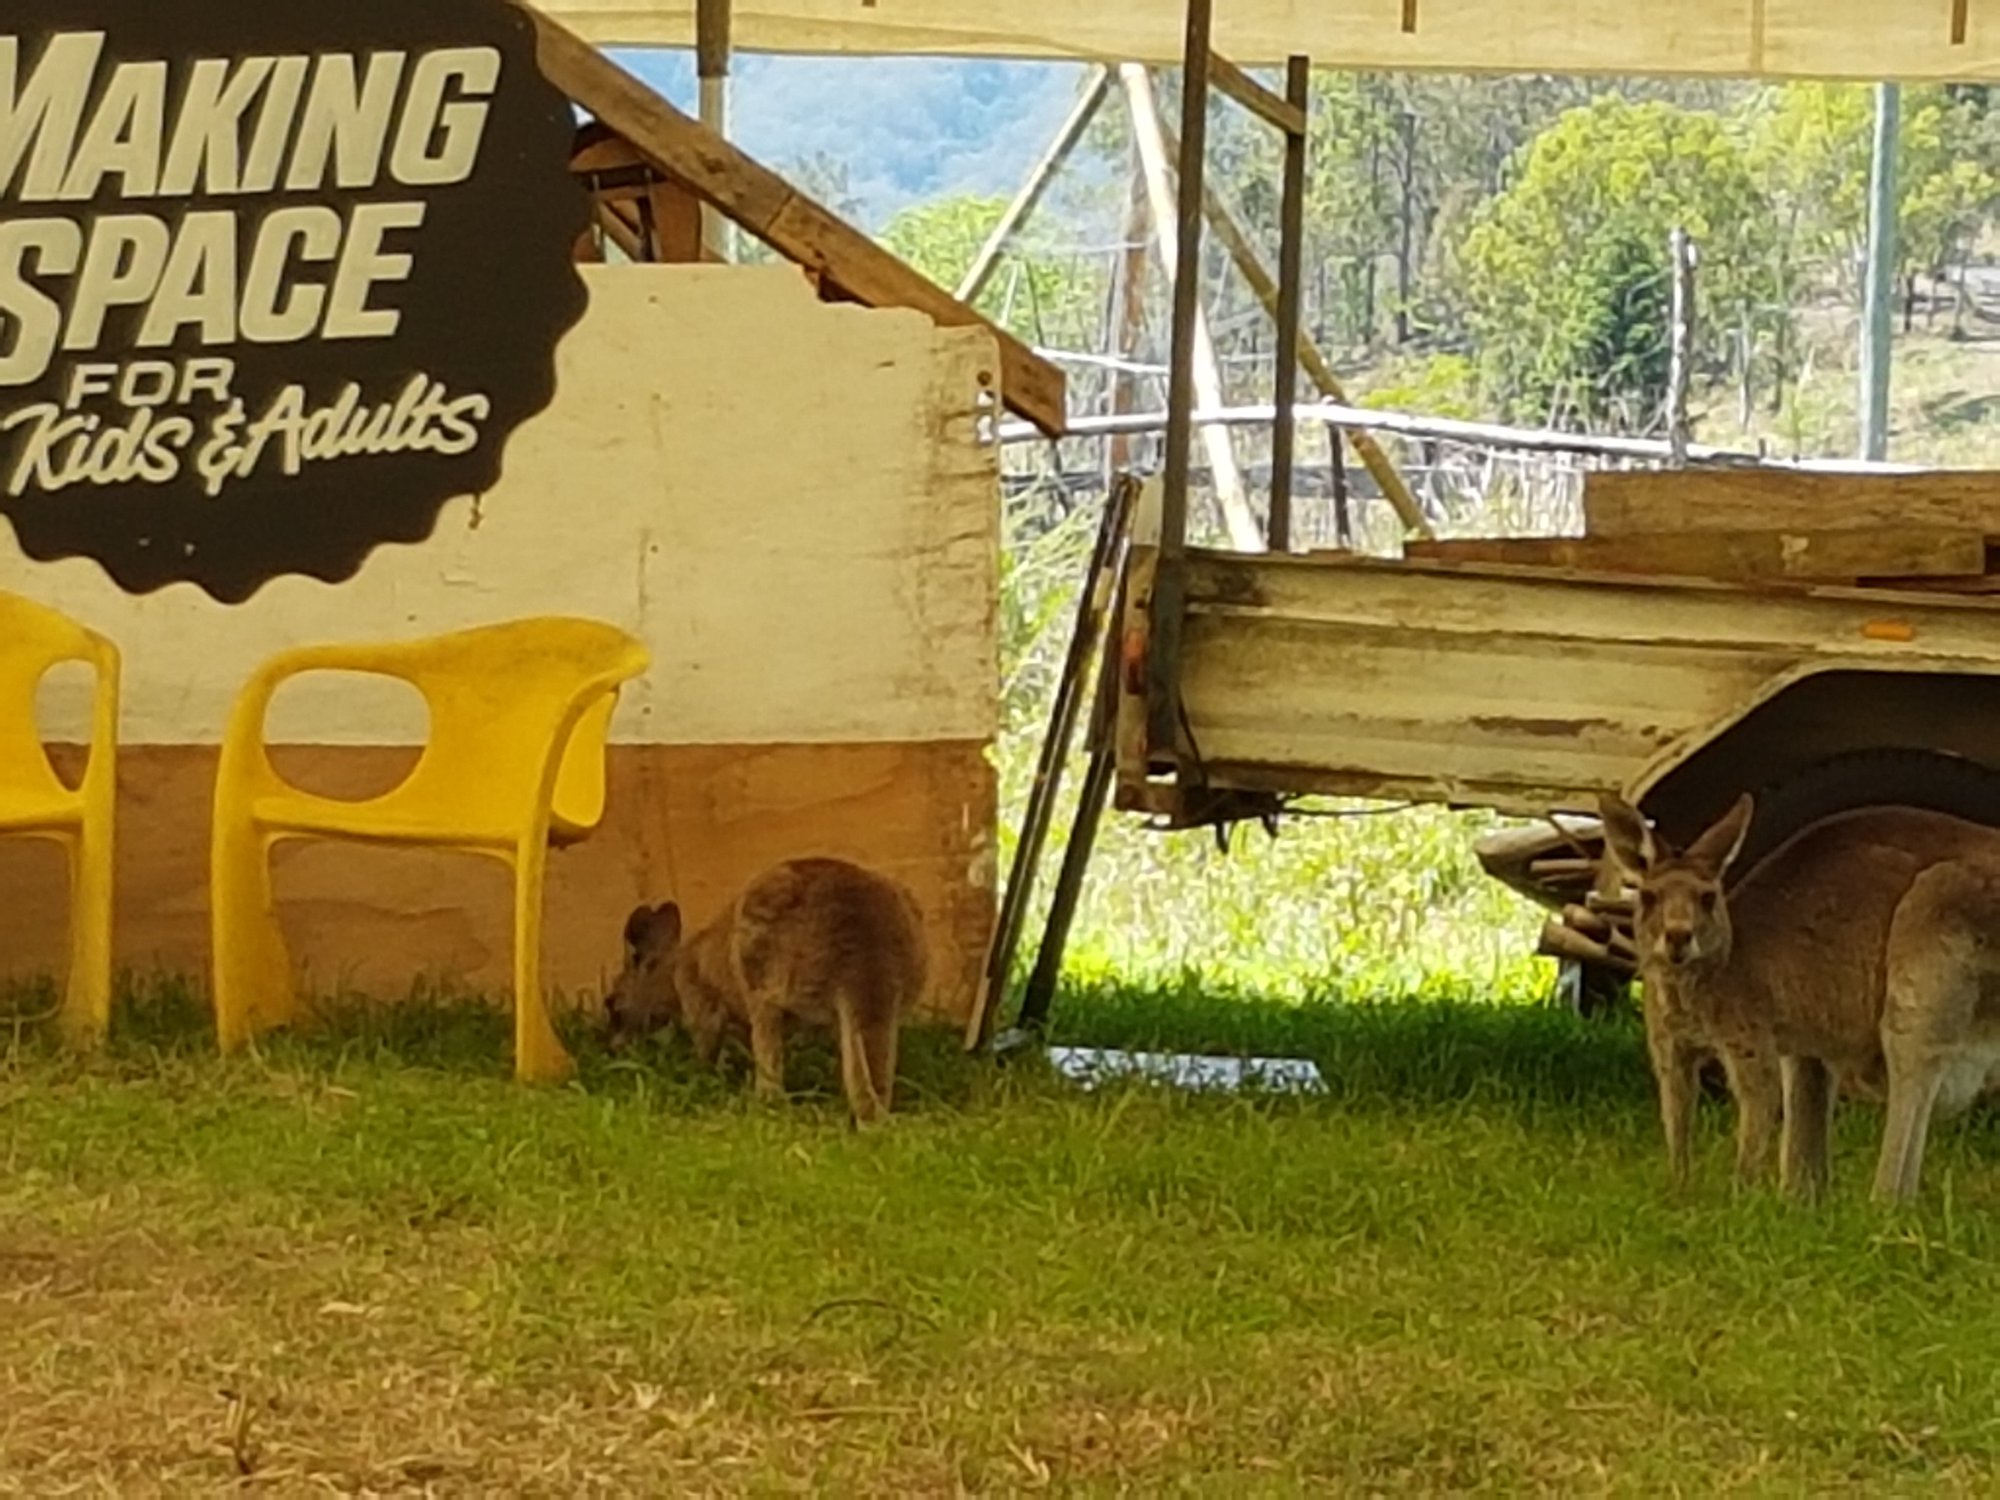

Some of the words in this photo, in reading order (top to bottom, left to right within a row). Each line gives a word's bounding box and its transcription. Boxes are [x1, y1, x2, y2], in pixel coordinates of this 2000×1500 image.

[0, 31, 500, 201] MAKING
[0, 202, 426, 386] SPACE
[2, 404, 193, 496] Kids
[238, 373, 489, 476] Adults
[66, 358, 236, 409] FOR
